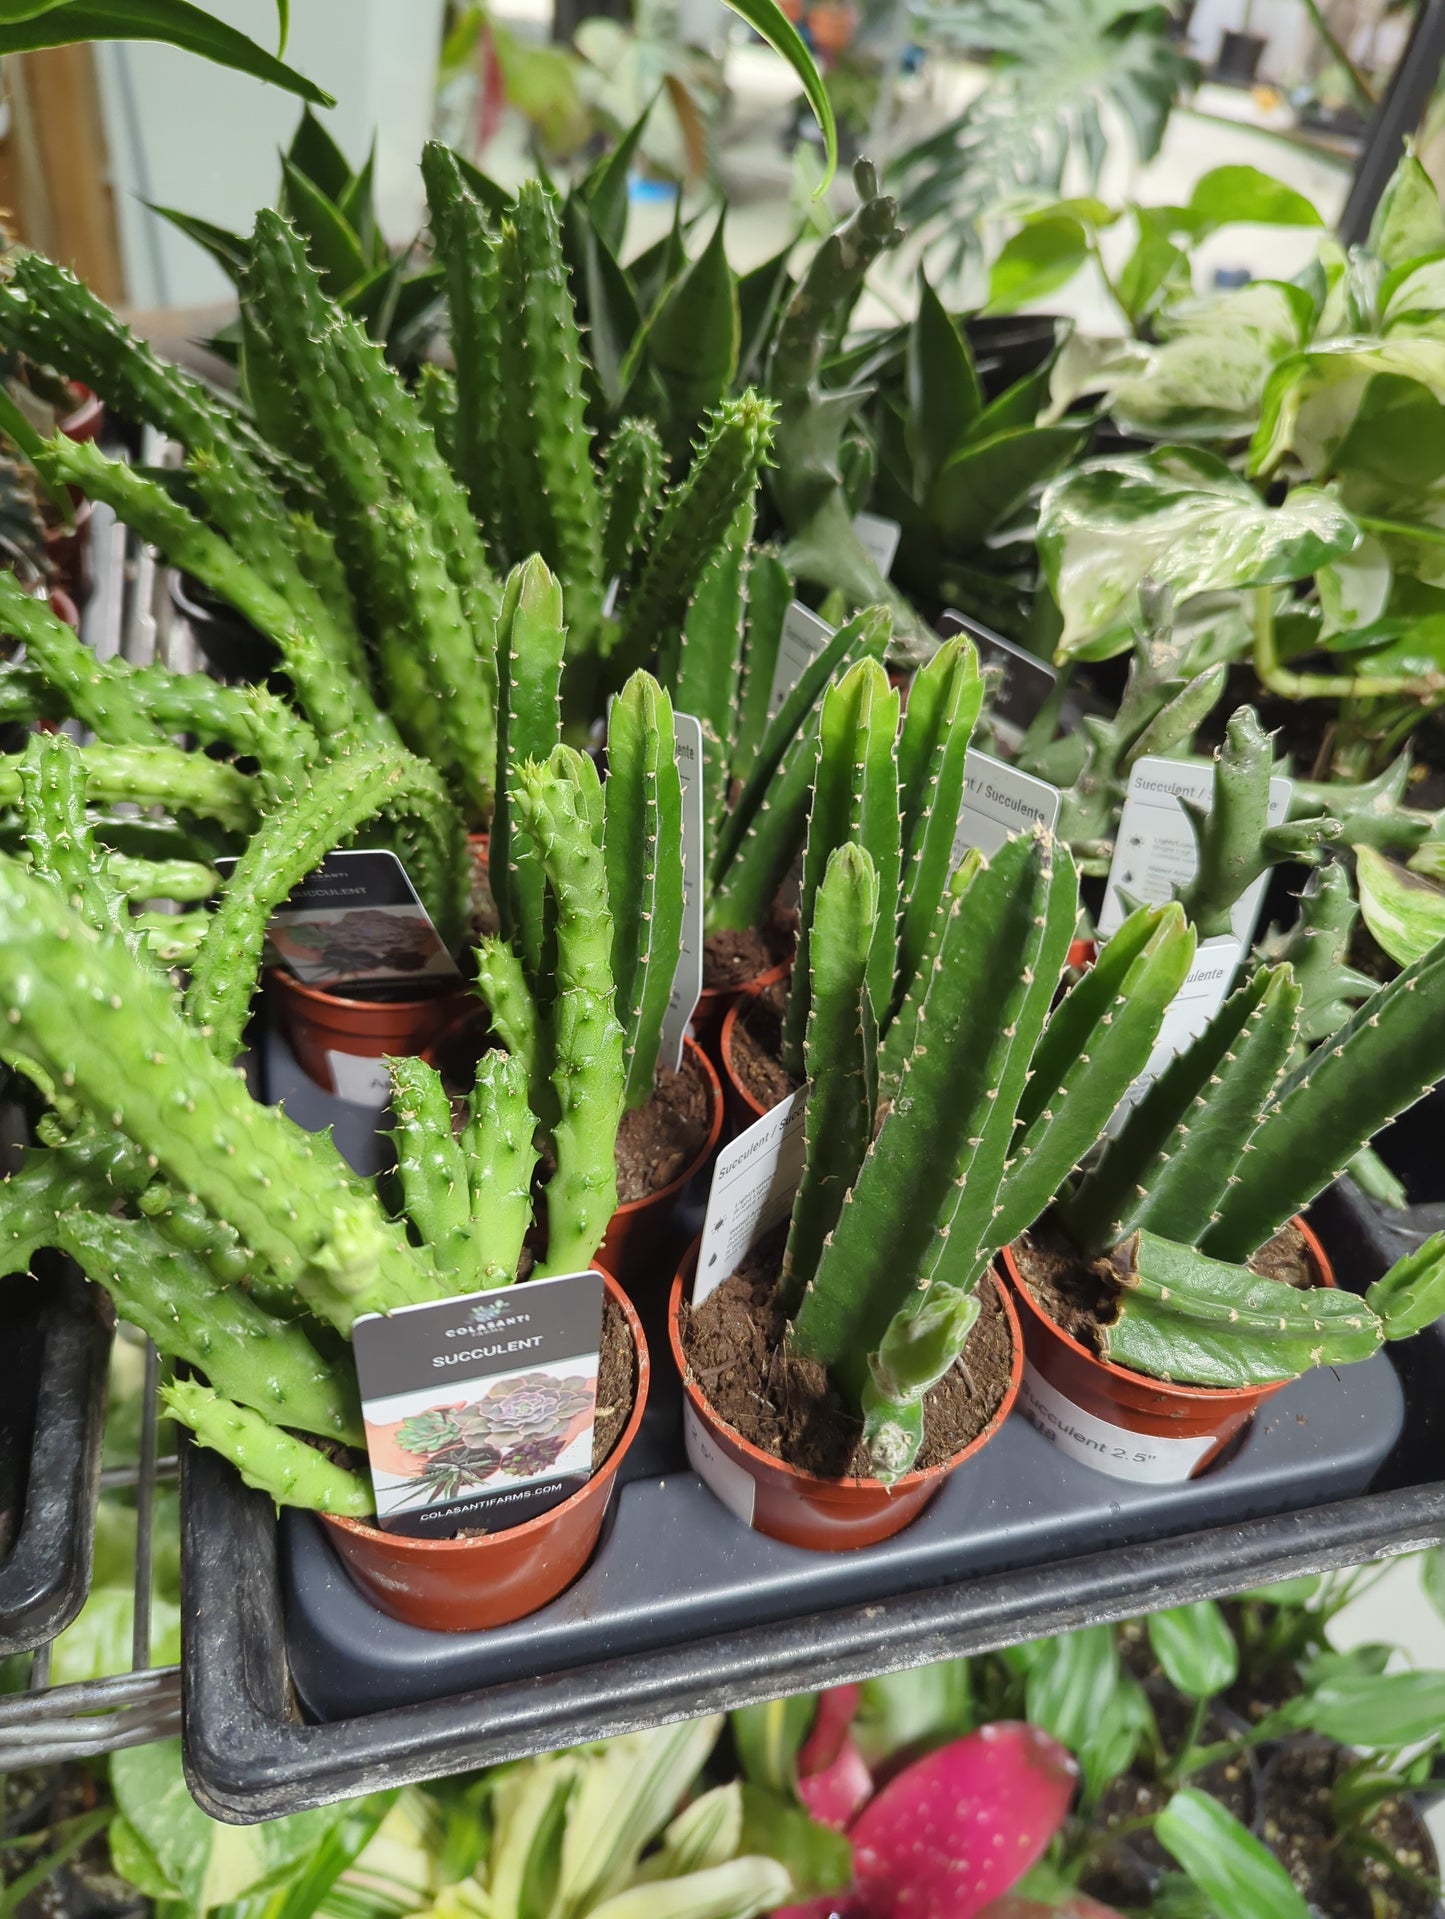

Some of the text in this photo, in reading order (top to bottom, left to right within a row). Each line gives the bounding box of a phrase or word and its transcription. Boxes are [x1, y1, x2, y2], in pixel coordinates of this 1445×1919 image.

[1135, 777, 1195, 797] Succulent
[985, 785, 1045, 822] Succulente
[1186, 968, 1224, 984] ulente
[719, 1132, 769, 1180] Succulent
[445, 1313, 531, 1338] COLASANTI
[432, 1335, 544, 1368] SUCCULENT
[1111, 1447, 1157, 1462] 2.5"
[420, 1483, 562, 1522] COLASANTIFARMS.COM
